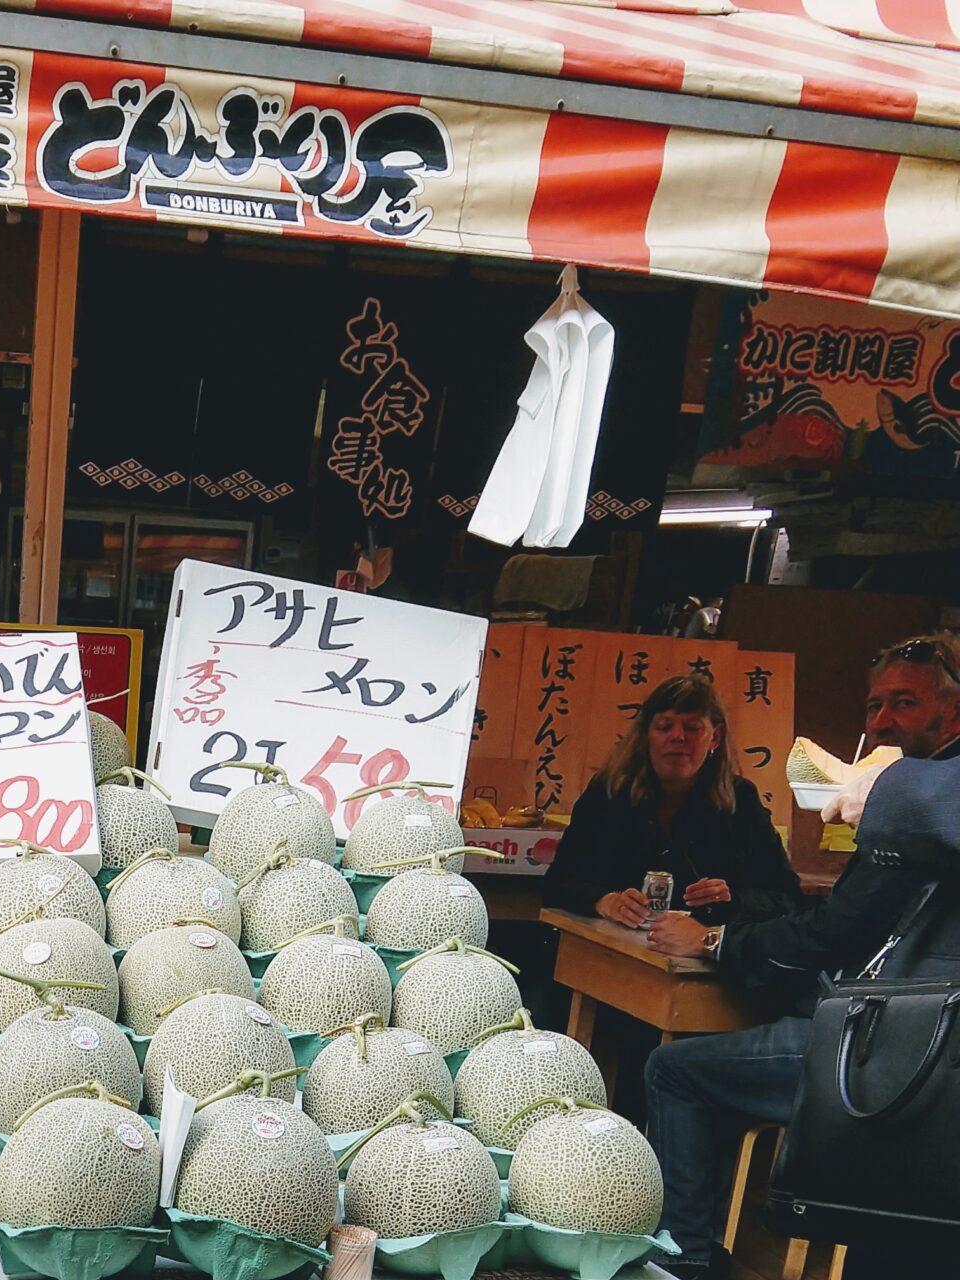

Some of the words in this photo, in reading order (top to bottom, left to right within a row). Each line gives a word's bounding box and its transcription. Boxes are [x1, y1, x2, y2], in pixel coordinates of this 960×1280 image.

[38, 80, 454, 238] どんぶり屋
[169, 192, 277, 220] DONBURIYA
[742, 326, 920, 382] かに卸問屋
[328, 298, 430, 519] お食事処
[204, 581, 364, 650] アサヒ
[302, 658, 471, 723] メロン
[534, 643, 583, 811] ぼたんえび
